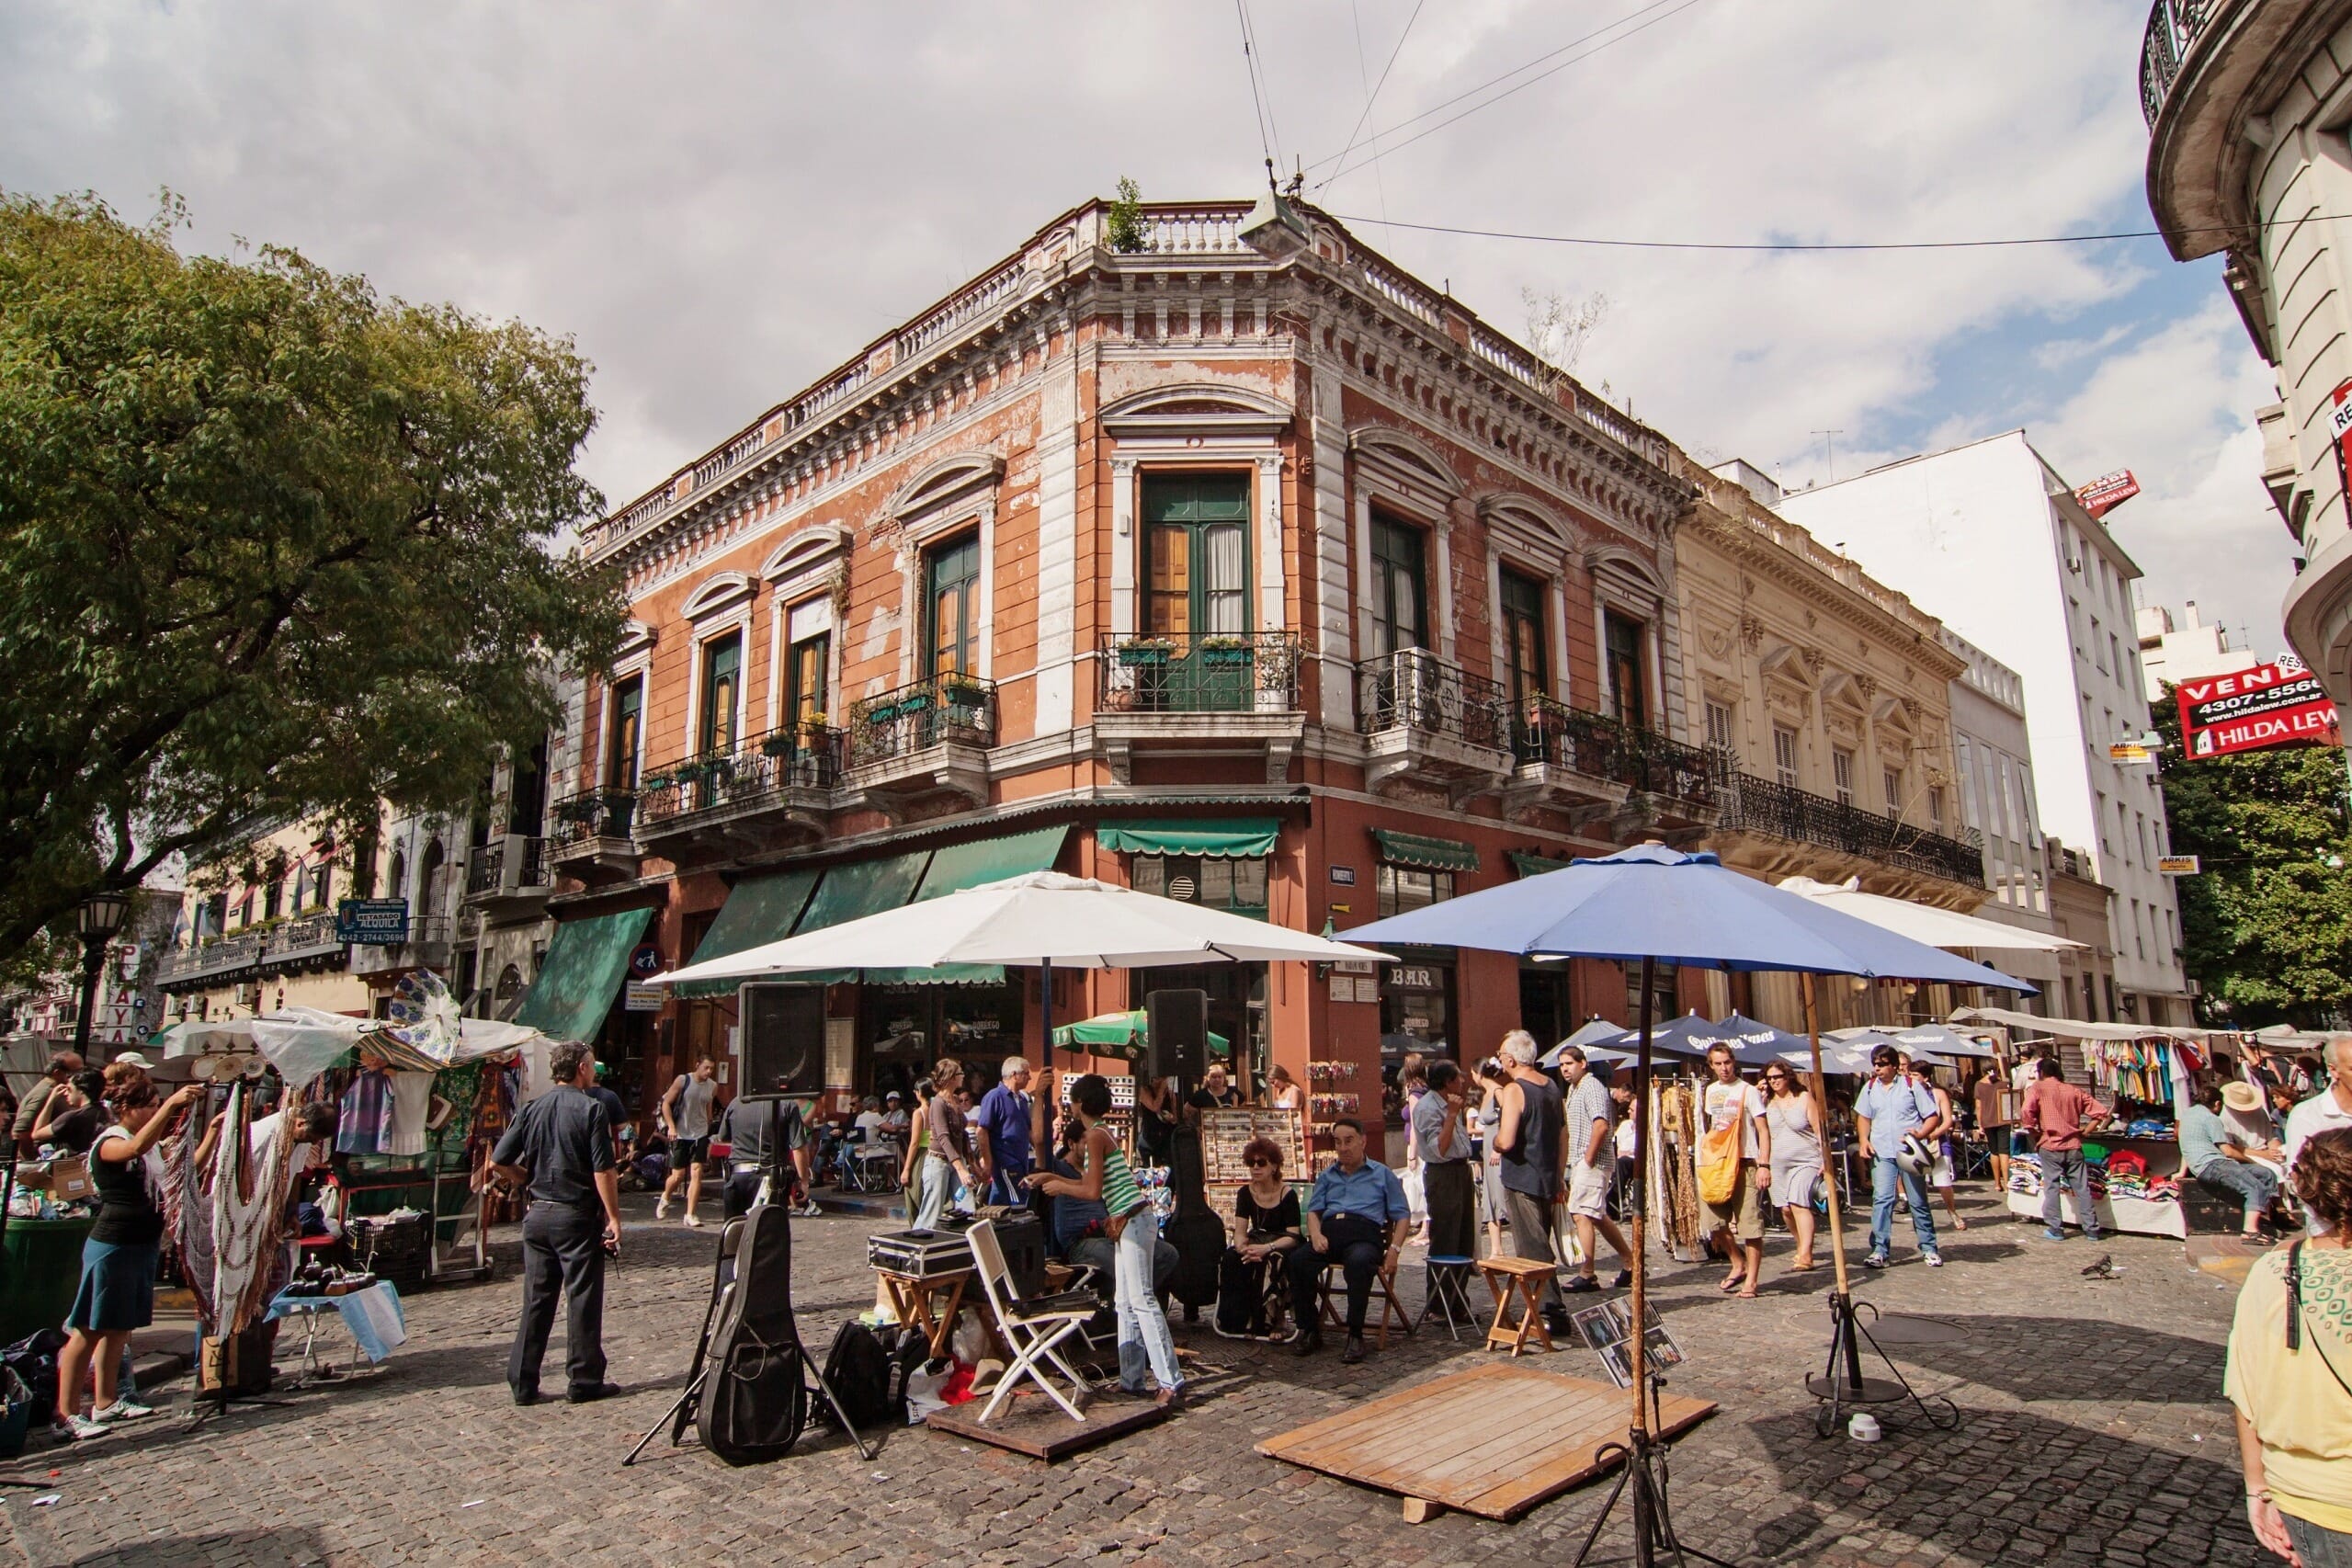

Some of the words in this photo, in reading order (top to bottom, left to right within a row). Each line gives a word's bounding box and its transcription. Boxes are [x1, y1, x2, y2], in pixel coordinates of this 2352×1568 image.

[2185, 666, 2308, 700] VEND
[2218, 719, 2290, 746] HILDA
[360, 919, 399, 927] ALQUILA
[1391, 969, 1431, 986] BAR
